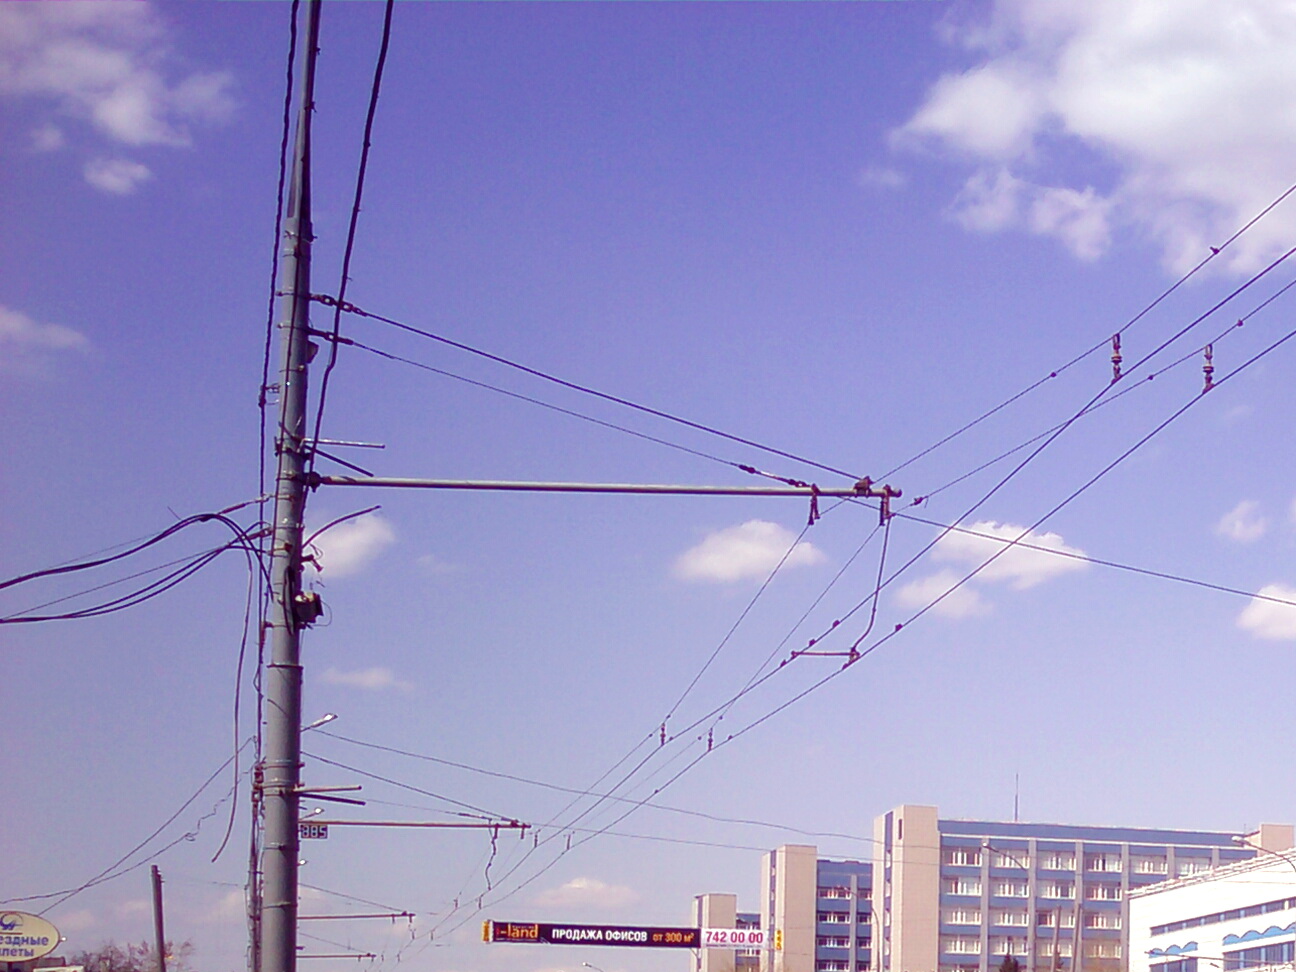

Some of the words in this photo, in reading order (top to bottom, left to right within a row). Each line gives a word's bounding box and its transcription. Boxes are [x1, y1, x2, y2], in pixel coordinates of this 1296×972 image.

[552, 929, 603, 941] ПРОДАЖА
[605, 931, 648, 942] ОФИСОВ
[664, 932, 682, 943] 300
[705, 931, 727, 943] 742
[730, 932, 745, 943] 00
[748, 932, 763, 944] 00
[0, 948, 34, 957] леты
